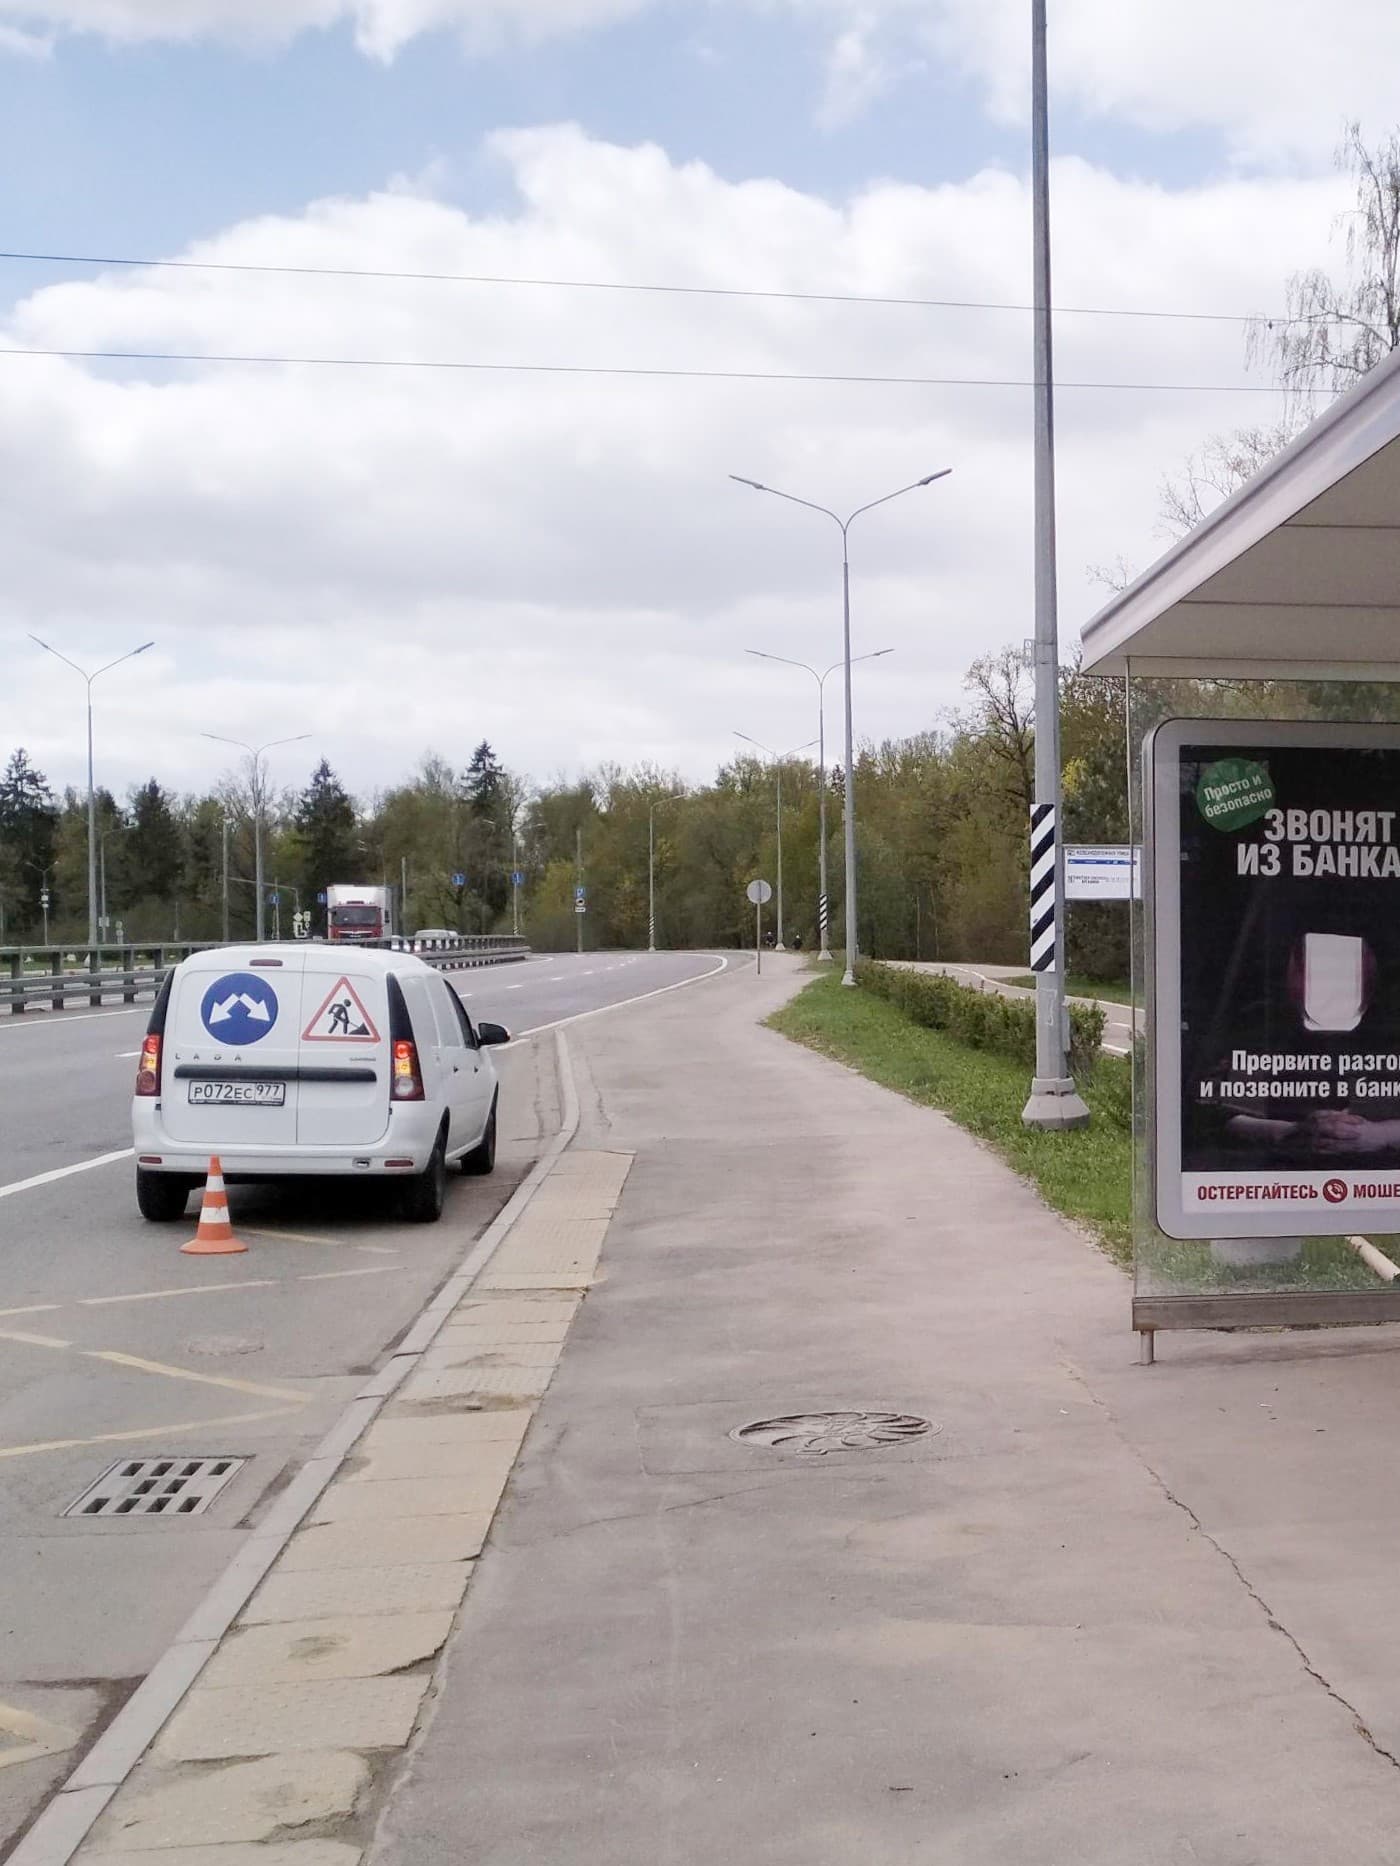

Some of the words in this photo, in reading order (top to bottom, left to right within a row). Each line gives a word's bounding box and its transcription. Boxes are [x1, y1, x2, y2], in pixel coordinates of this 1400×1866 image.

[1203, 778, 1250, 801] Просто
[1251, 774, 1263, 786] и
[1205, 788, 1273, 818] безопасно
[1264, 808, 1396, 843] ЗВОНЯТ
[1237, 842, 1281, 876] ИЗ
[1232, 1050, 1332, 1075] Прервите
[1200, 1081, 1213, 1097] и
[1220, 1081, 1330, 1098] позвоните
[1337, 1081, 1349, 1097] в
[1198, 1182, 1318, 1200] ОСТЕРЕГАЙТЕСЬ
